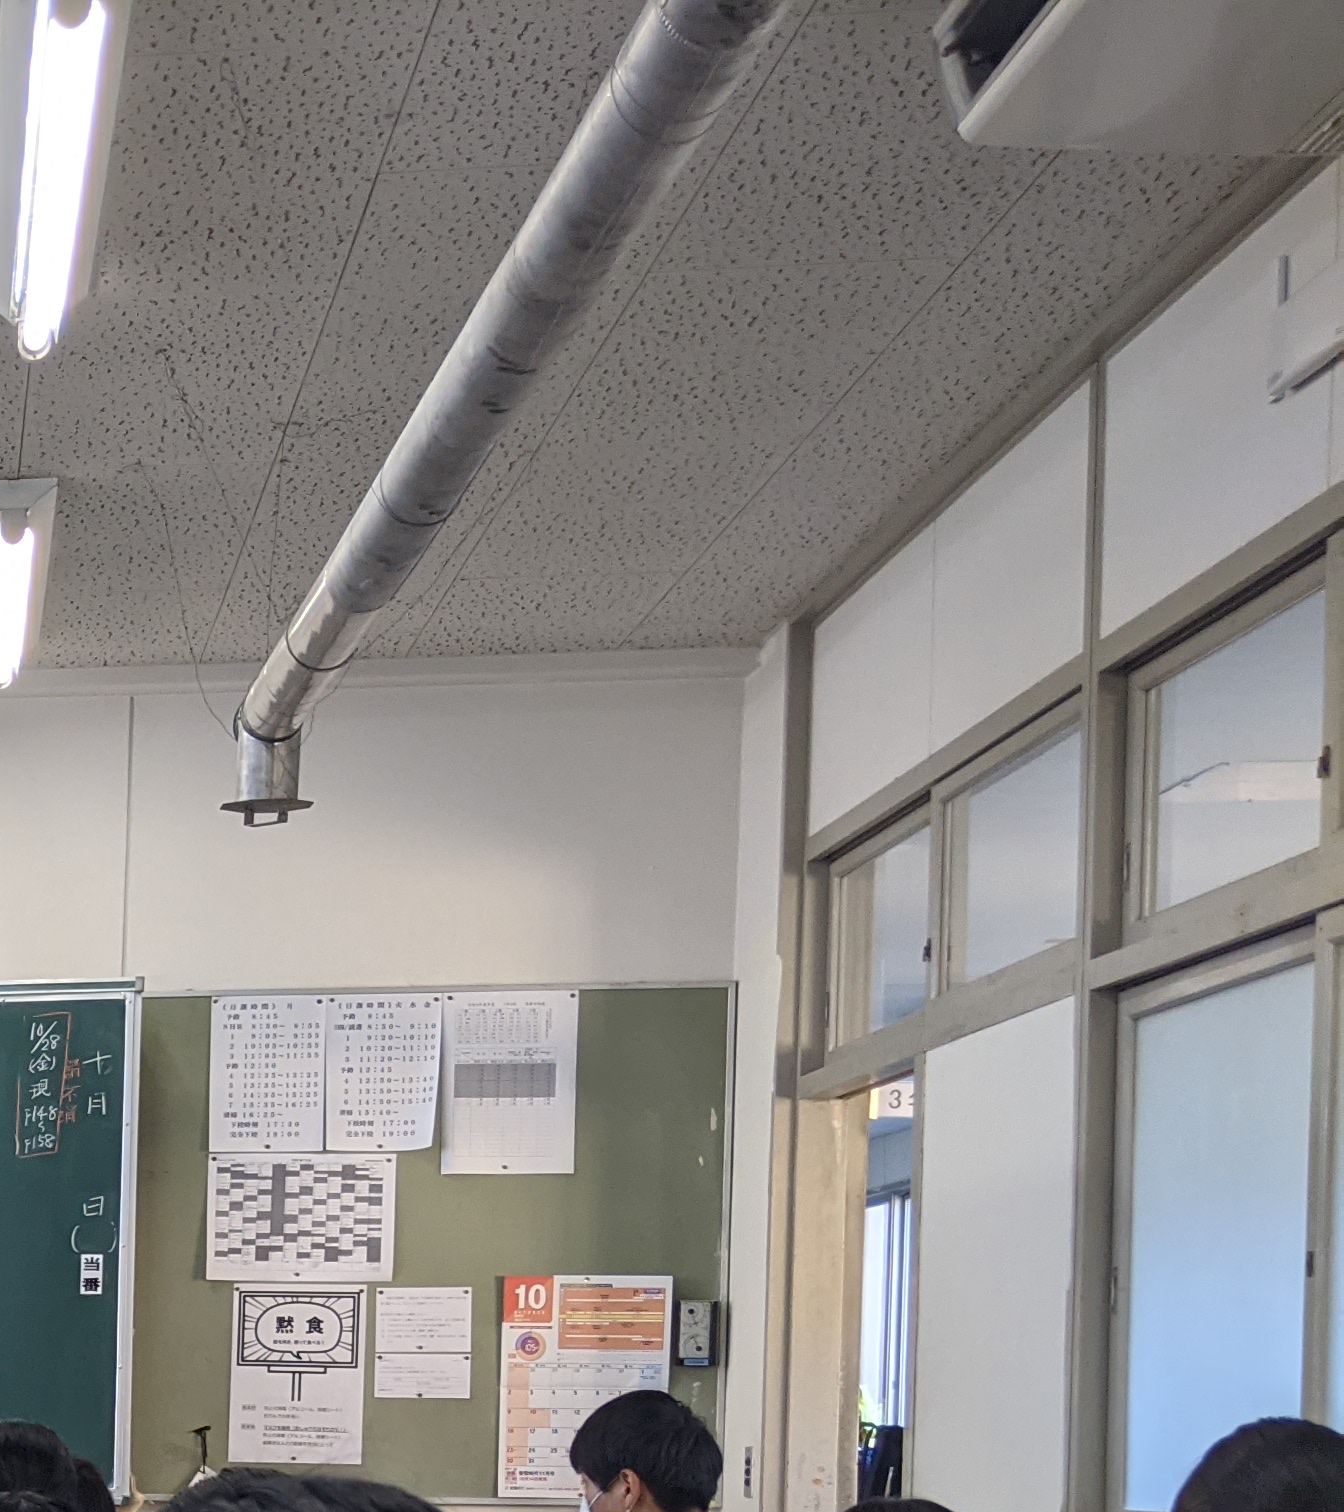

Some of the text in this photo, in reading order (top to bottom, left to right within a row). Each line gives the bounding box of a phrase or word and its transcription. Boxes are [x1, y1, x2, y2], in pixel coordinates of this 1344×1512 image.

[28, 1020, 61, 1054] 10/28
[29, 1078, 52, 1100] 現
[81, 1256, 101, 1293] 当番
[515, 1284, 546, 1310] 10
[275, 1315, 324, 1335] 黙食
